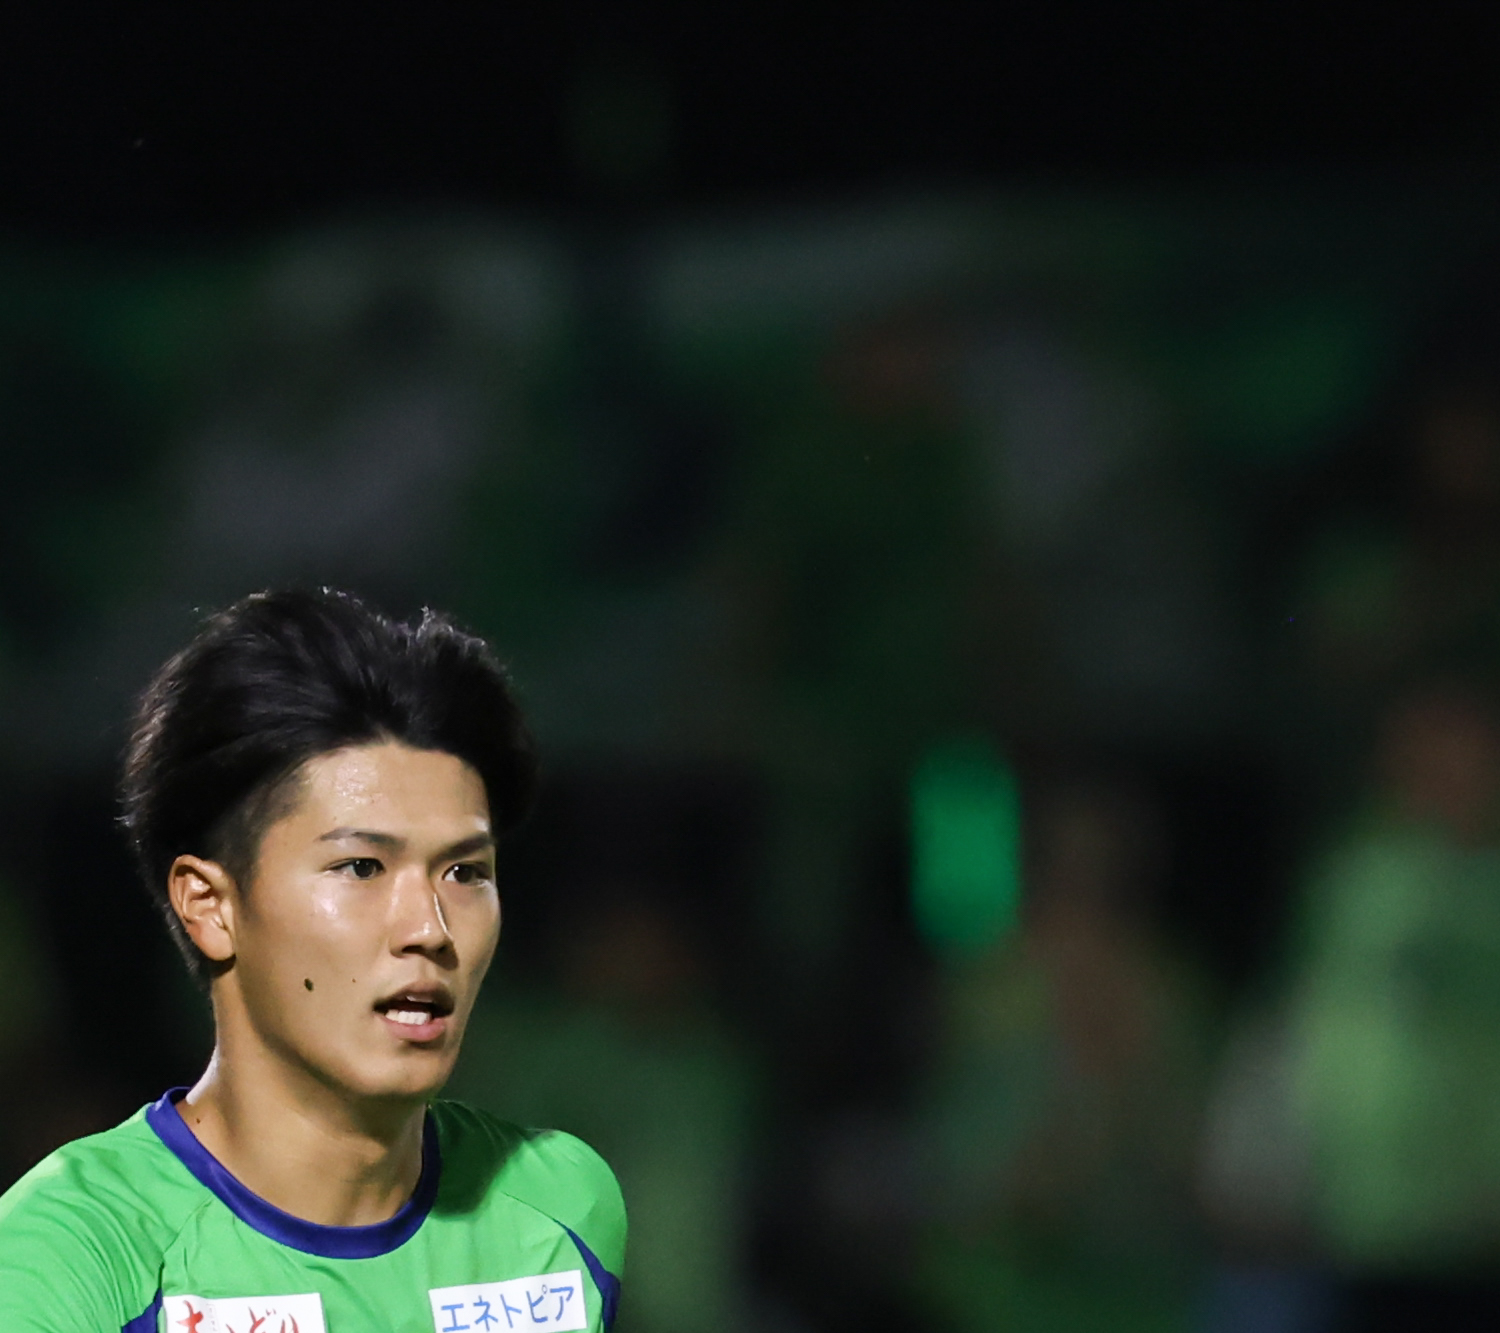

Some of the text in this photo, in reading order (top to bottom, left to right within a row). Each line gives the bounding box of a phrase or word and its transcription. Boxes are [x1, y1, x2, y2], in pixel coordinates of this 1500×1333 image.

[440, 1284, 575, 1333] エネトピア
